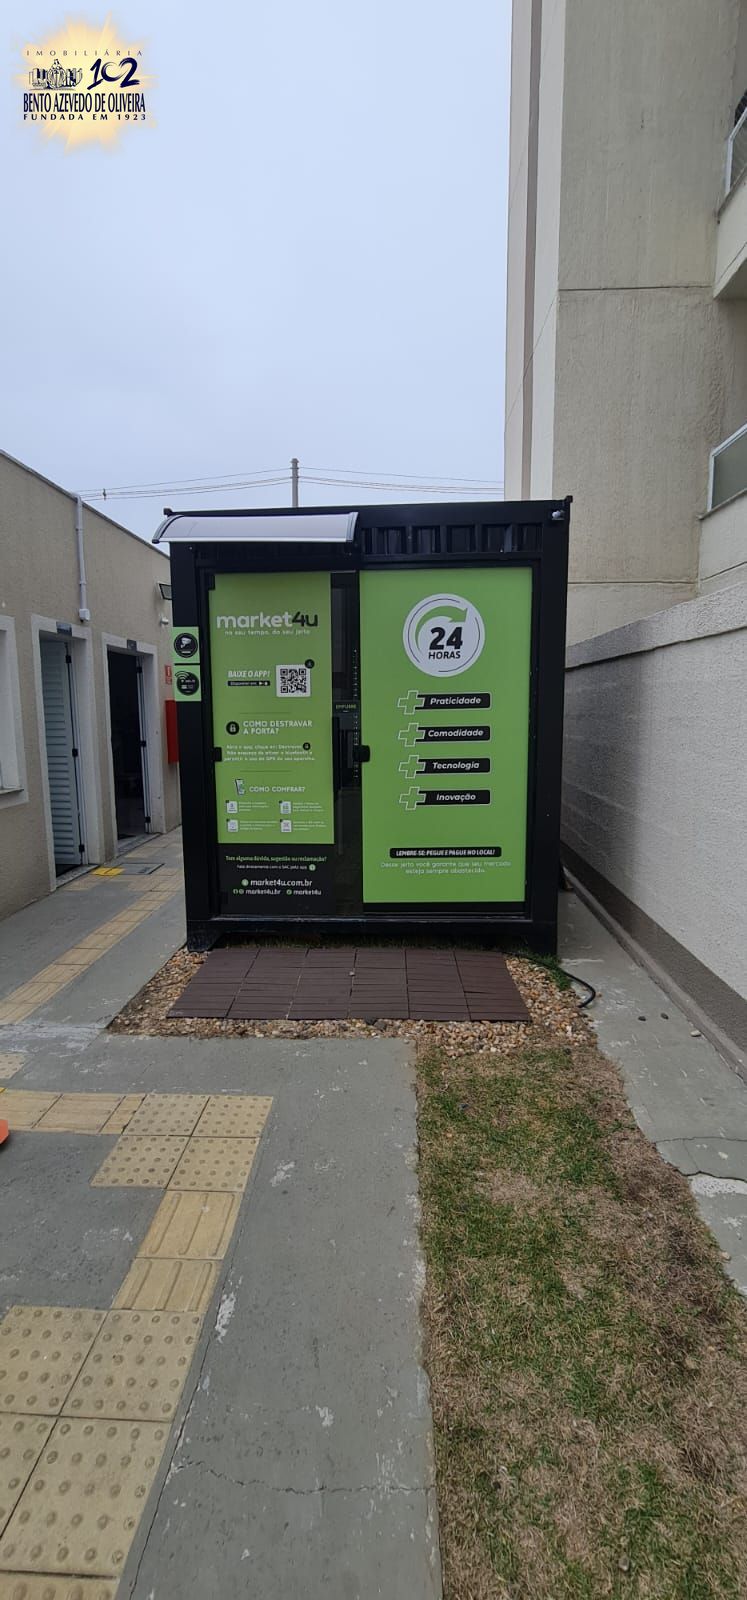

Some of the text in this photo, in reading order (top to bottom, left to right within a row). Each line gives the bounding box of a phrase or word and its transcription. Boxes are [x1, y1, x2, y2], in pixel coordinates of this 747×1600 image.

[216, 611, 318, 628] market4u
[429, 626, 463, 650] 24
[428, 651, 461, 660] HORAS
[430, 696, 481, 705] Praticidade
[428, 729, 484, 737] Comodidade
[432, 761, 480, 770] Tecnologia
[436, 793, 476, 802] Inovação
